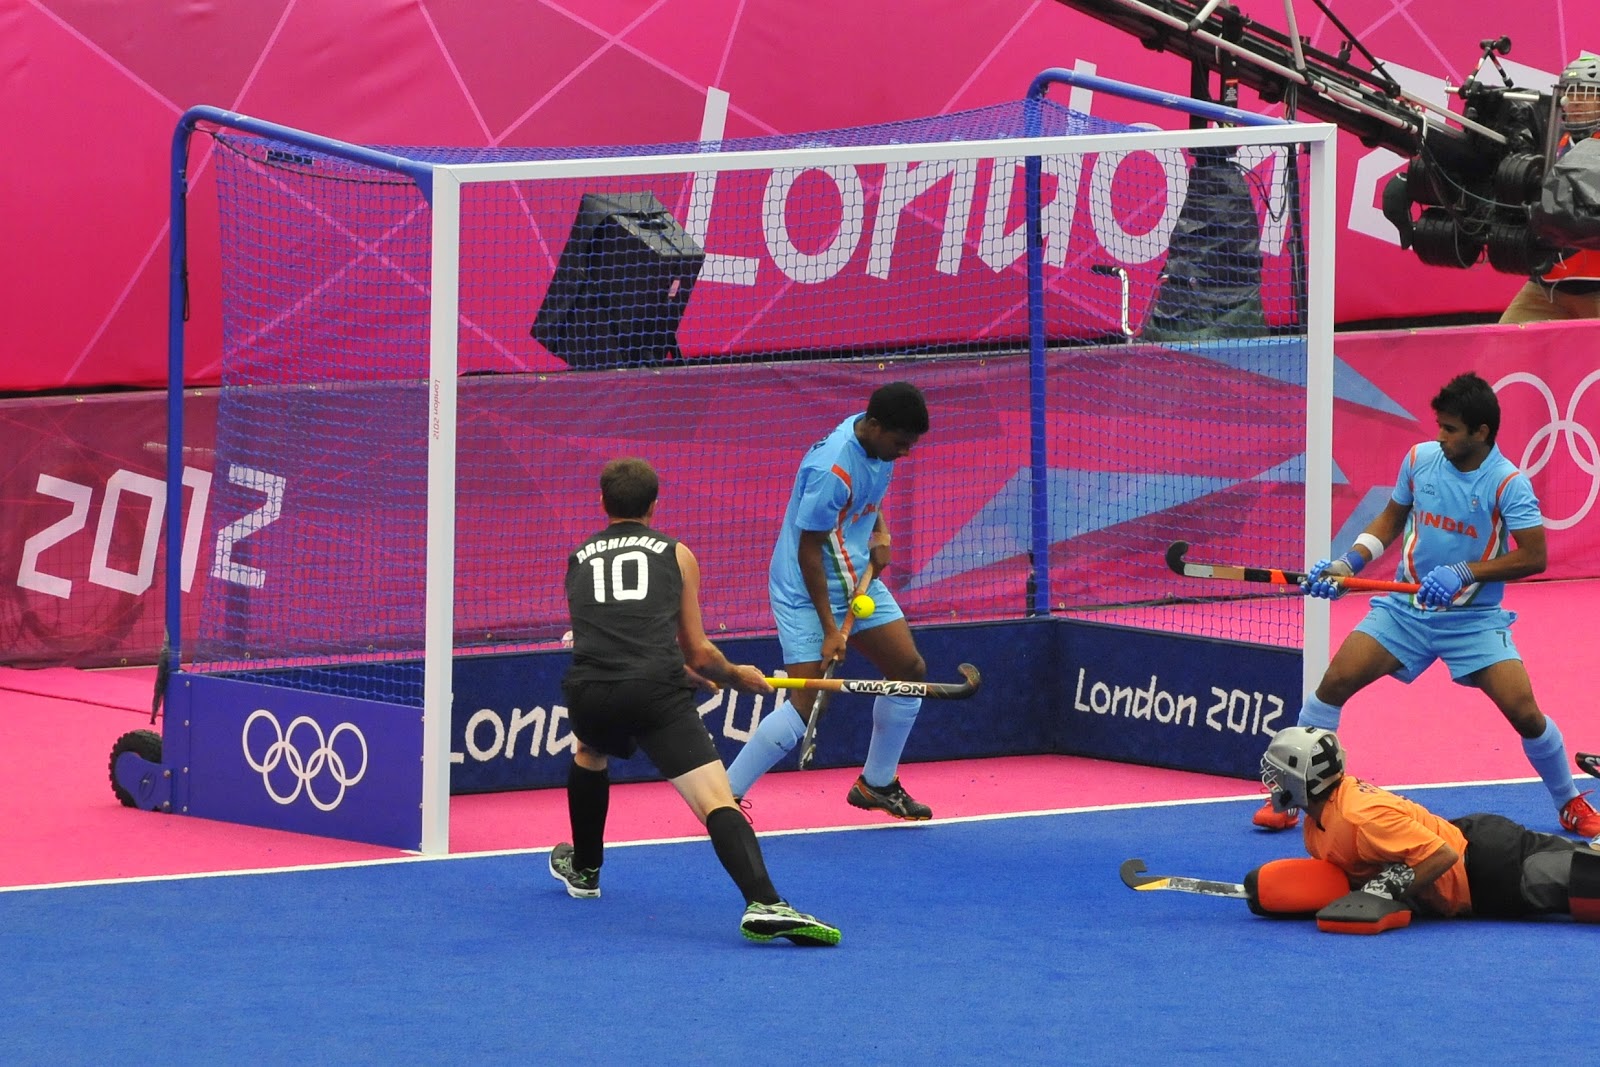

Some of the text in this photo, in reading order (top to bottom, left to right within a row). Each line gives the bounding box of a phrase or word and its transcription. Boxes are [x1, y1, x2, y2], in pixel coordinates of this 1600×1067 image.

[685, 58, 1299, 286] London
[17, 464, 286, 599] 2012
[1420, 511, 1478, 538] INDIA
[576, 536, 668, 564] ARCHIBALD
[589, 551, 649, 603] 10
[1496, 631, 1507, 648] 7
[856, 681, 927, 696] MAZON
[1074, 667, 1284, 738] London 2012
